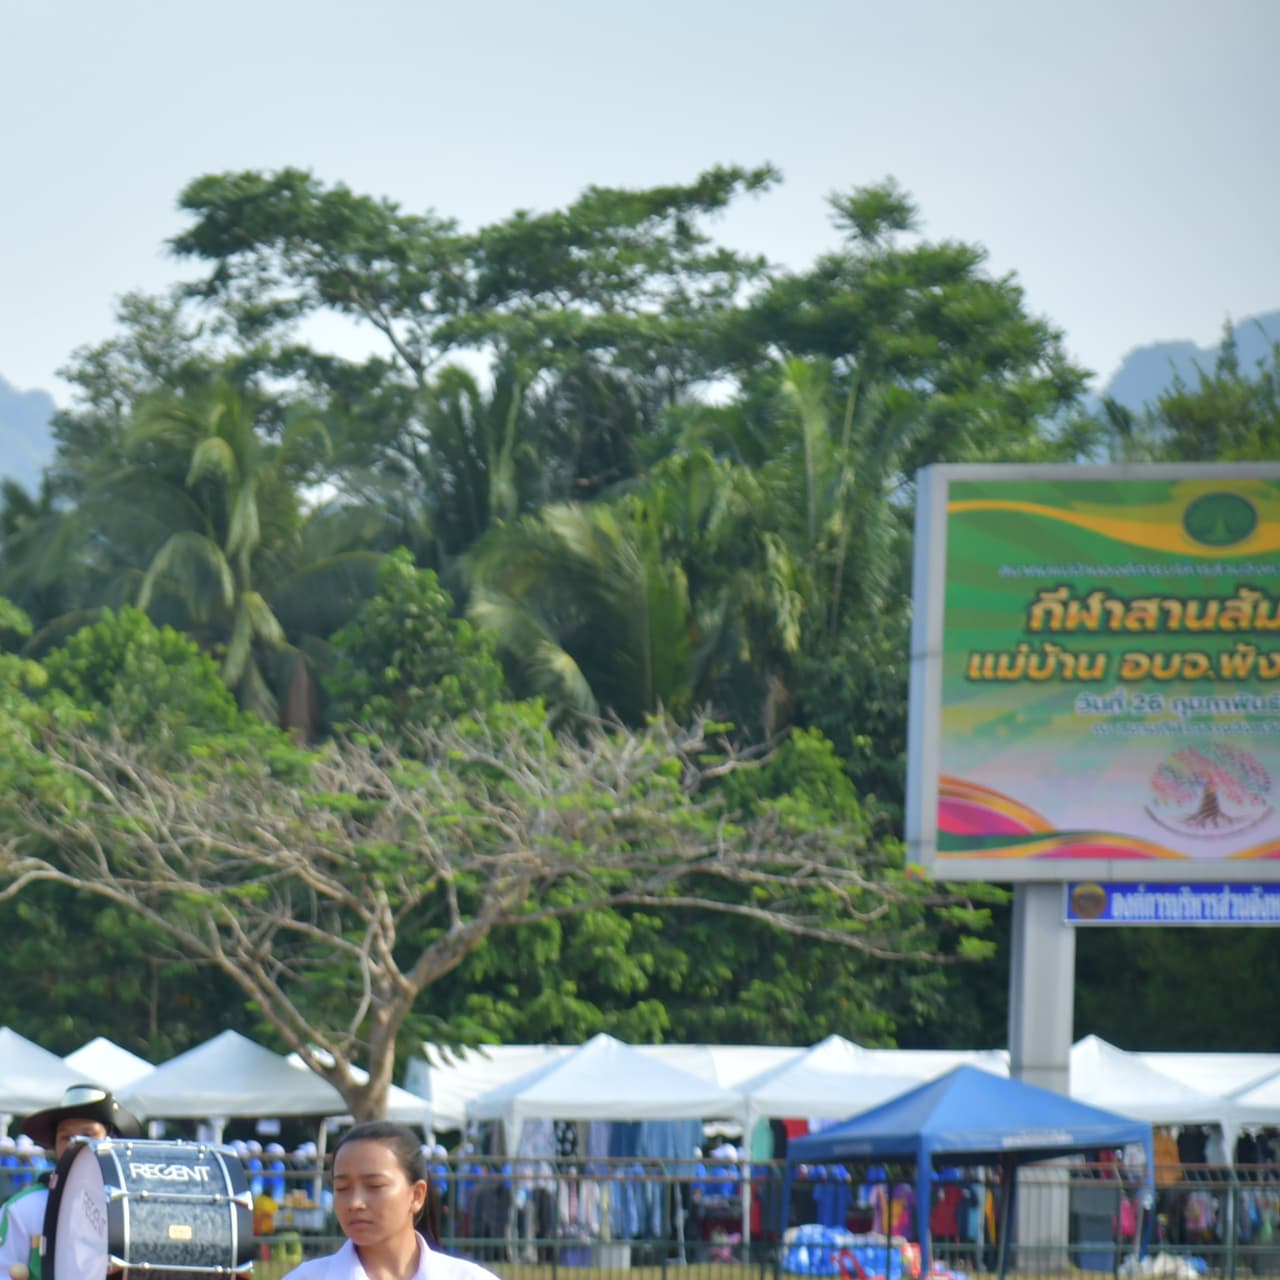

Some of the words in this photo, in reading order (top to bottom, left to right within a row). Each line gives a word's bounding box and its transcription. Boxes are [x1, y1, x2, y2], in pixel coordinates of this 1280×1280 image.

[966, 642, 1108, 681] แม่บ้าน
[128, 1162, 211, 1181] REGENT
